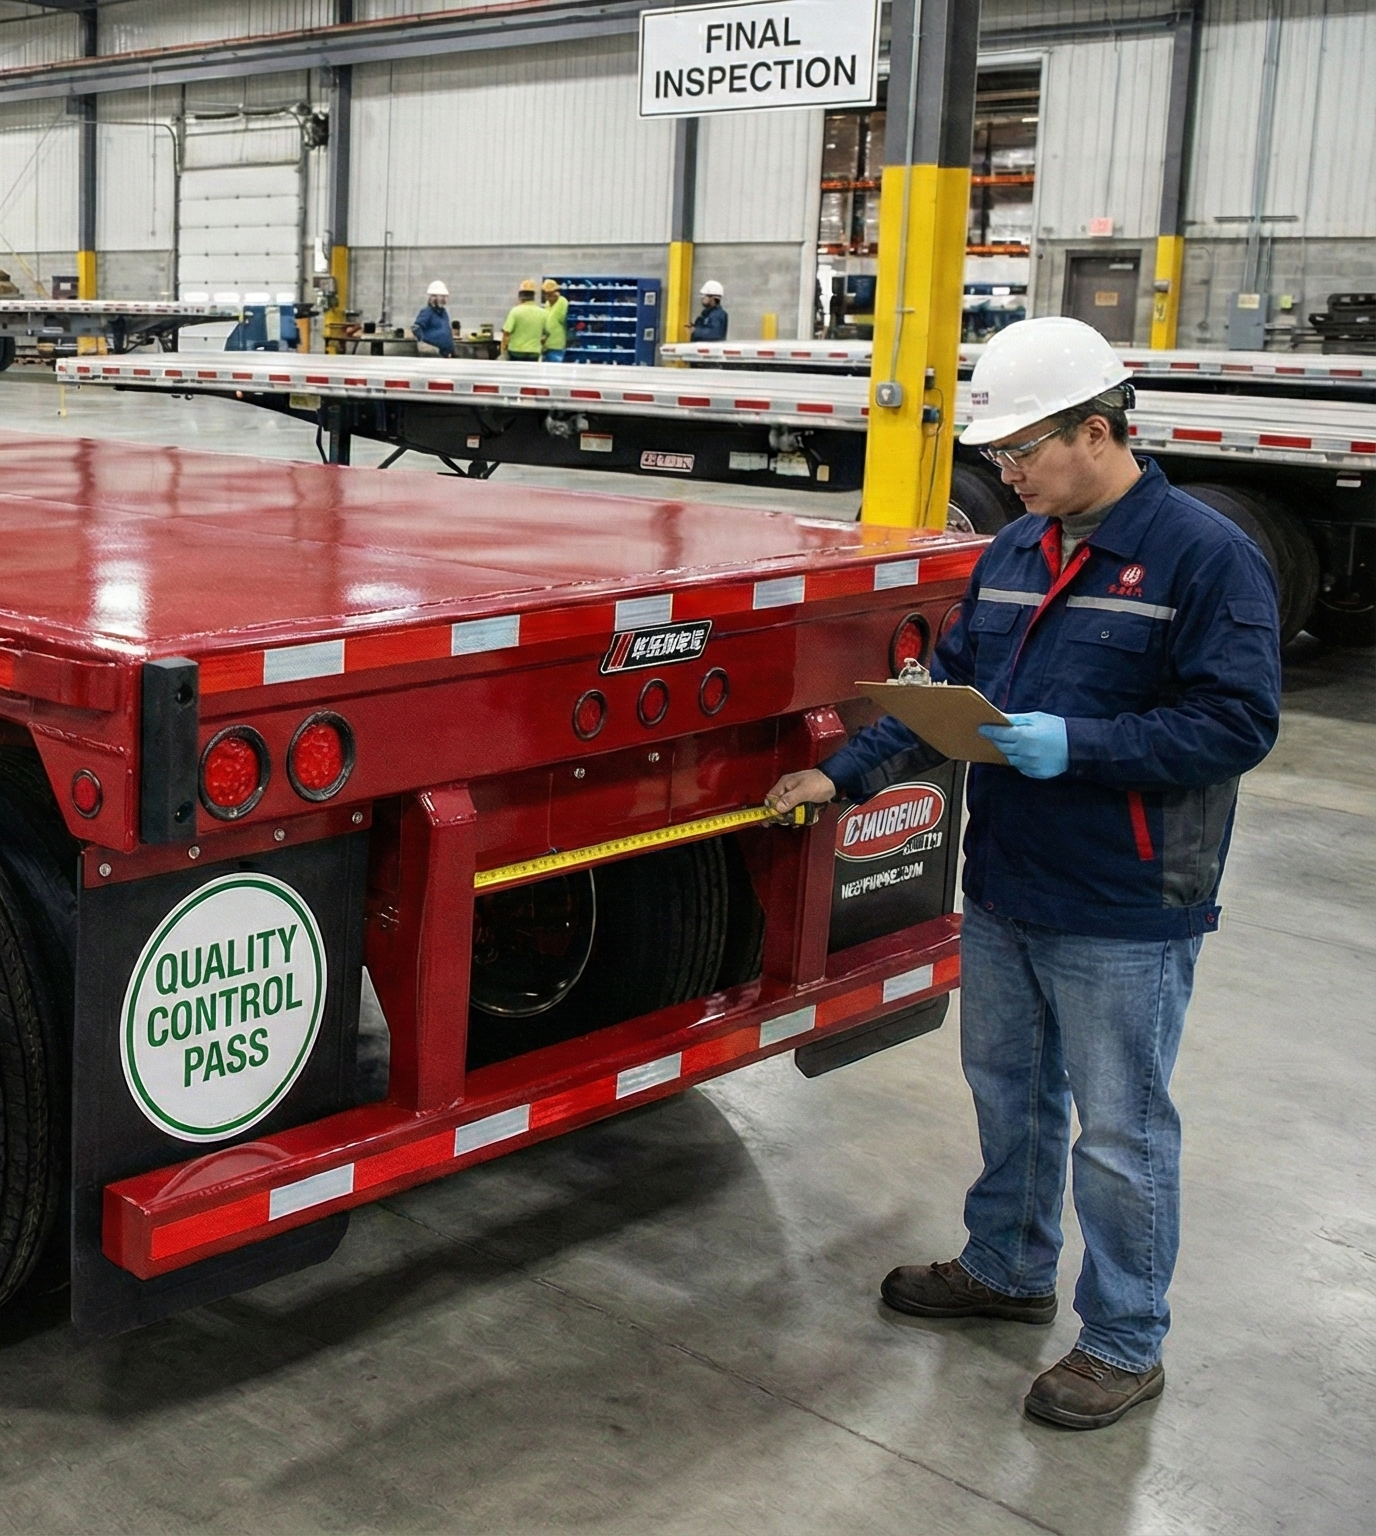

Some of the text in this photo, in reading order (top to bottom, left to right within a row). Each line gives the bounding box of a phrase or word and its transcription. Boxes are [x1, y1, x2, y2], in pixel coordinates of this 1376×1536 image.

[706, 16, 801, 54] FINAL
[655, 54, 857, 99] INSPECTION
[155, 924, 298, 996] QUALITY
[147, 972, 303, 1048] CONTROL
[184, 1027, 269, 1088] PASS
